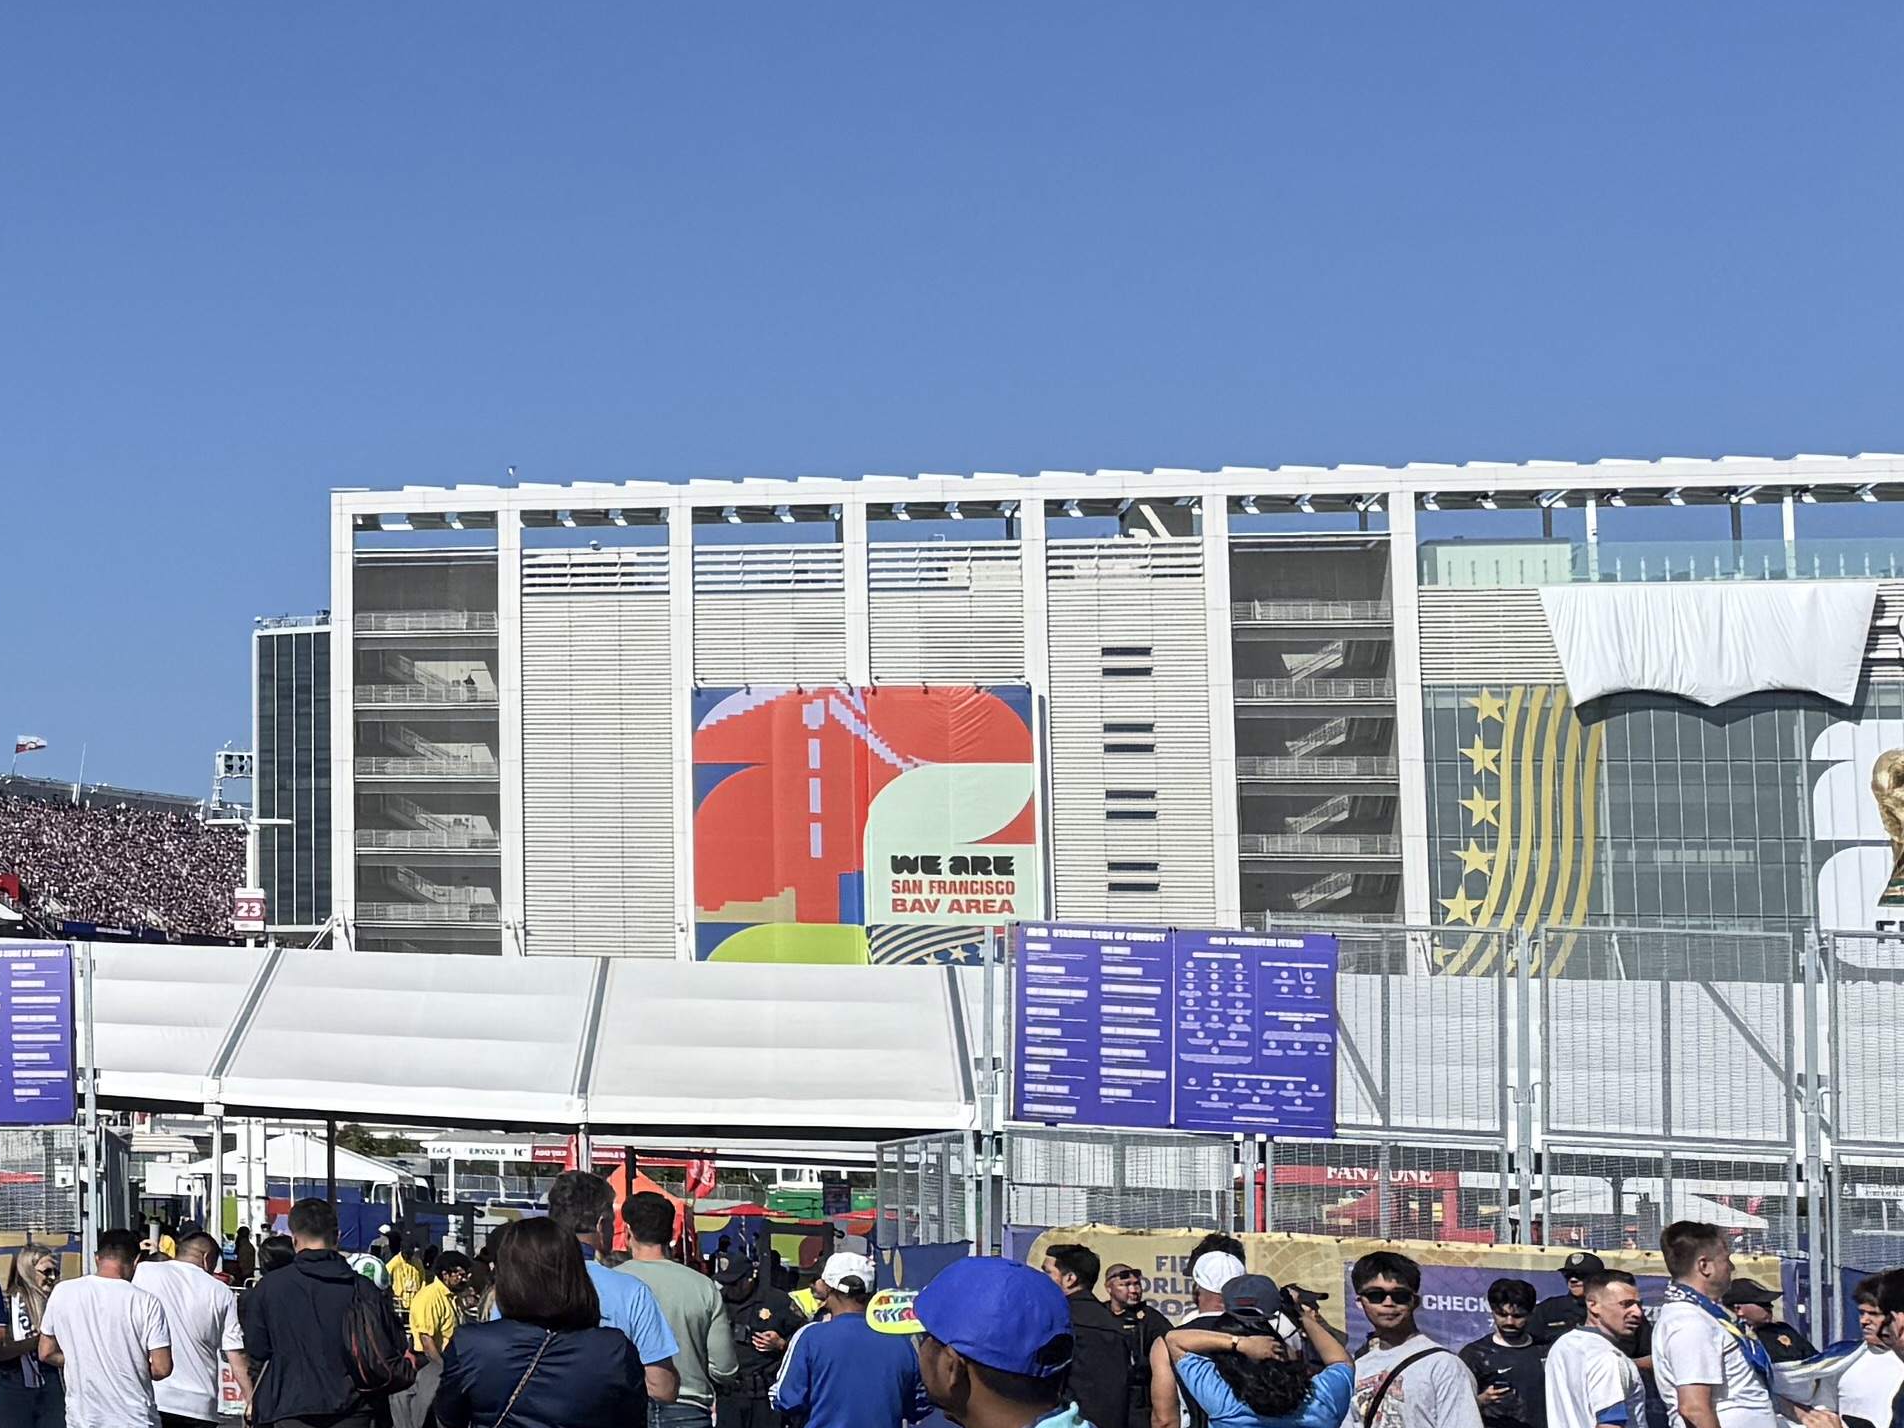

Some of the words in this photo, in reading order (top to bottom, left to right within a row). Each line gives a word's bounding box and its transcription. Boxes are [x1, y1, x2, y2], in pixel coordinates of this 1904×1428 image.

[890, 855, 942, 875] WE
[891, 879, 923, 895] SAN
[929, 880, 1015, 895] FRANCISCO
[237, 902, 261, 917] 23
[891, 898, 941, 914] BAY
[947, 898, 1015, 914] AREA
[1156, 1255, 1191, 1273] FIF
